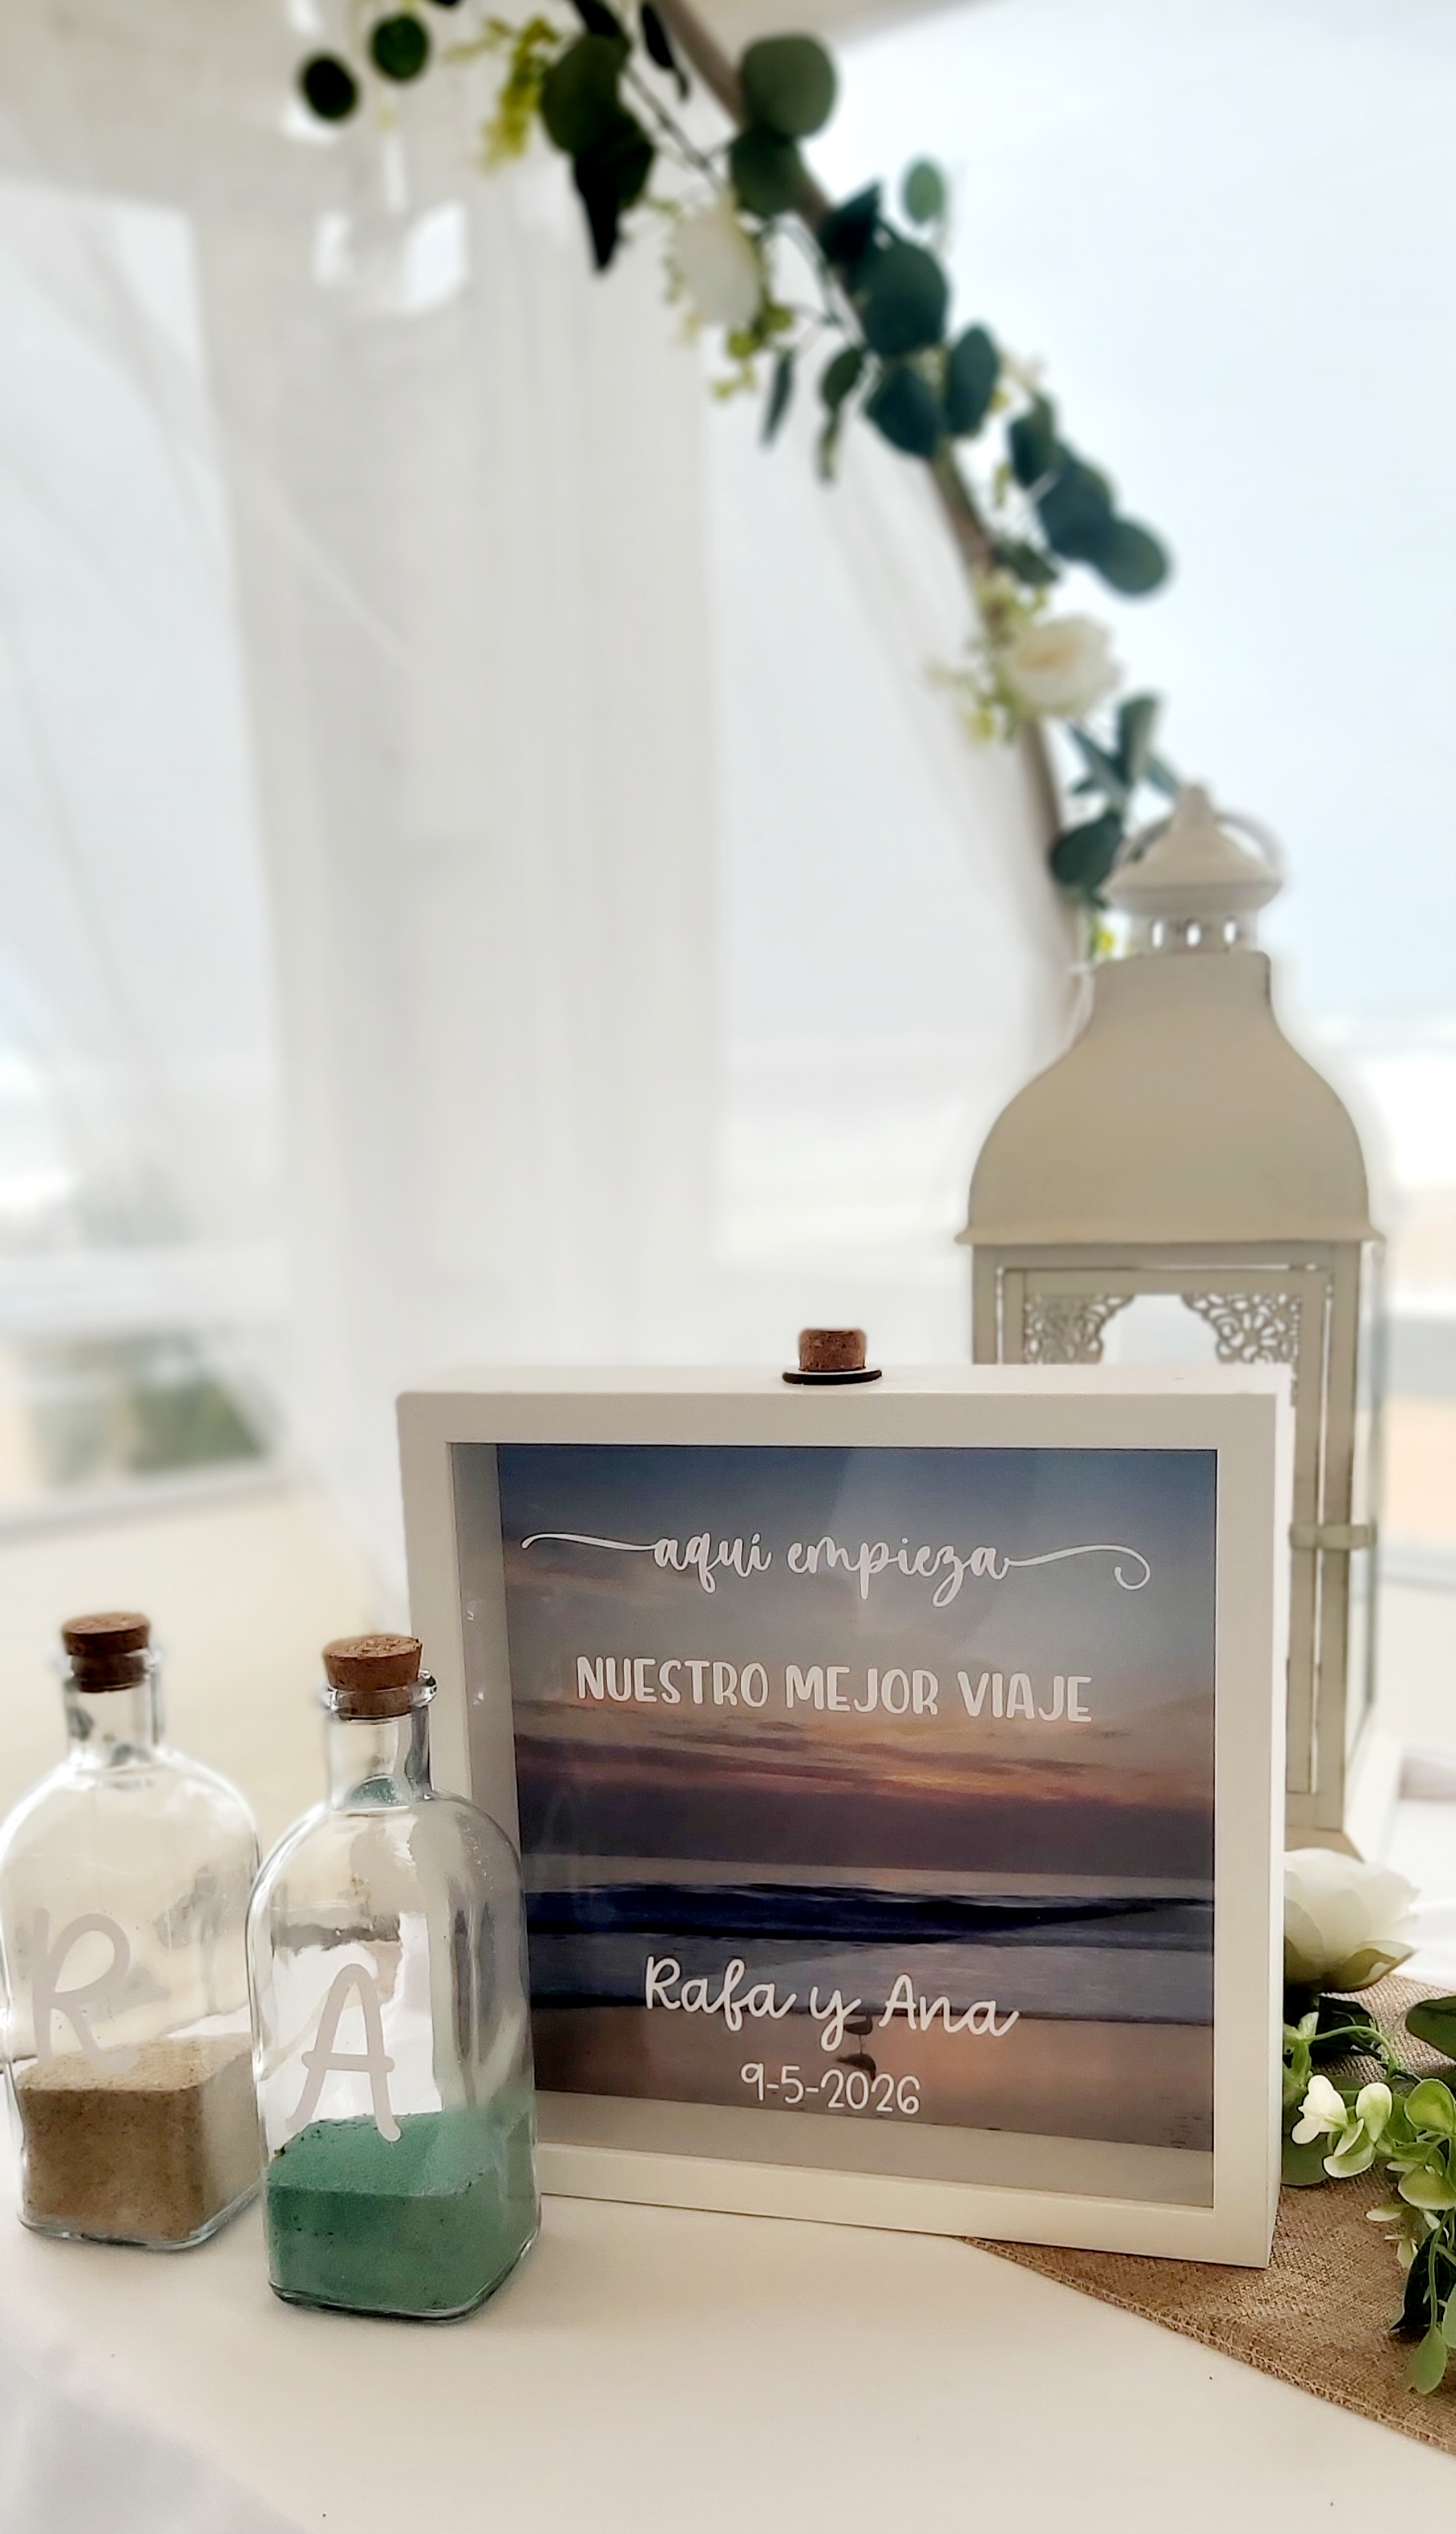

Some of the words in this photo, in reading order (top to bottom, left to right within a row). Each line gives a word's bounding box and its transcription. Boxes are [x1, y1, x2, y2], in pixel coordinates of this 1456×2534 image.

[786, 1536, 1012, 1607] empieza
[576, 1656, 768, 1708] NUESTRO
[785, 1664, 938, 1716] MEJOR
[957, 1671, 1093, 1722] VIAJE
[32, 1908, 139, 2072] R
[645, 1956, 797, 2031] Rafa
[809, 1986, 862, 2051] y
[879, 1974, 1019, 2037] Ana
[285, 1963, 401, 2142] A
[740, 2062, 920, 2115] 9-5-2026
